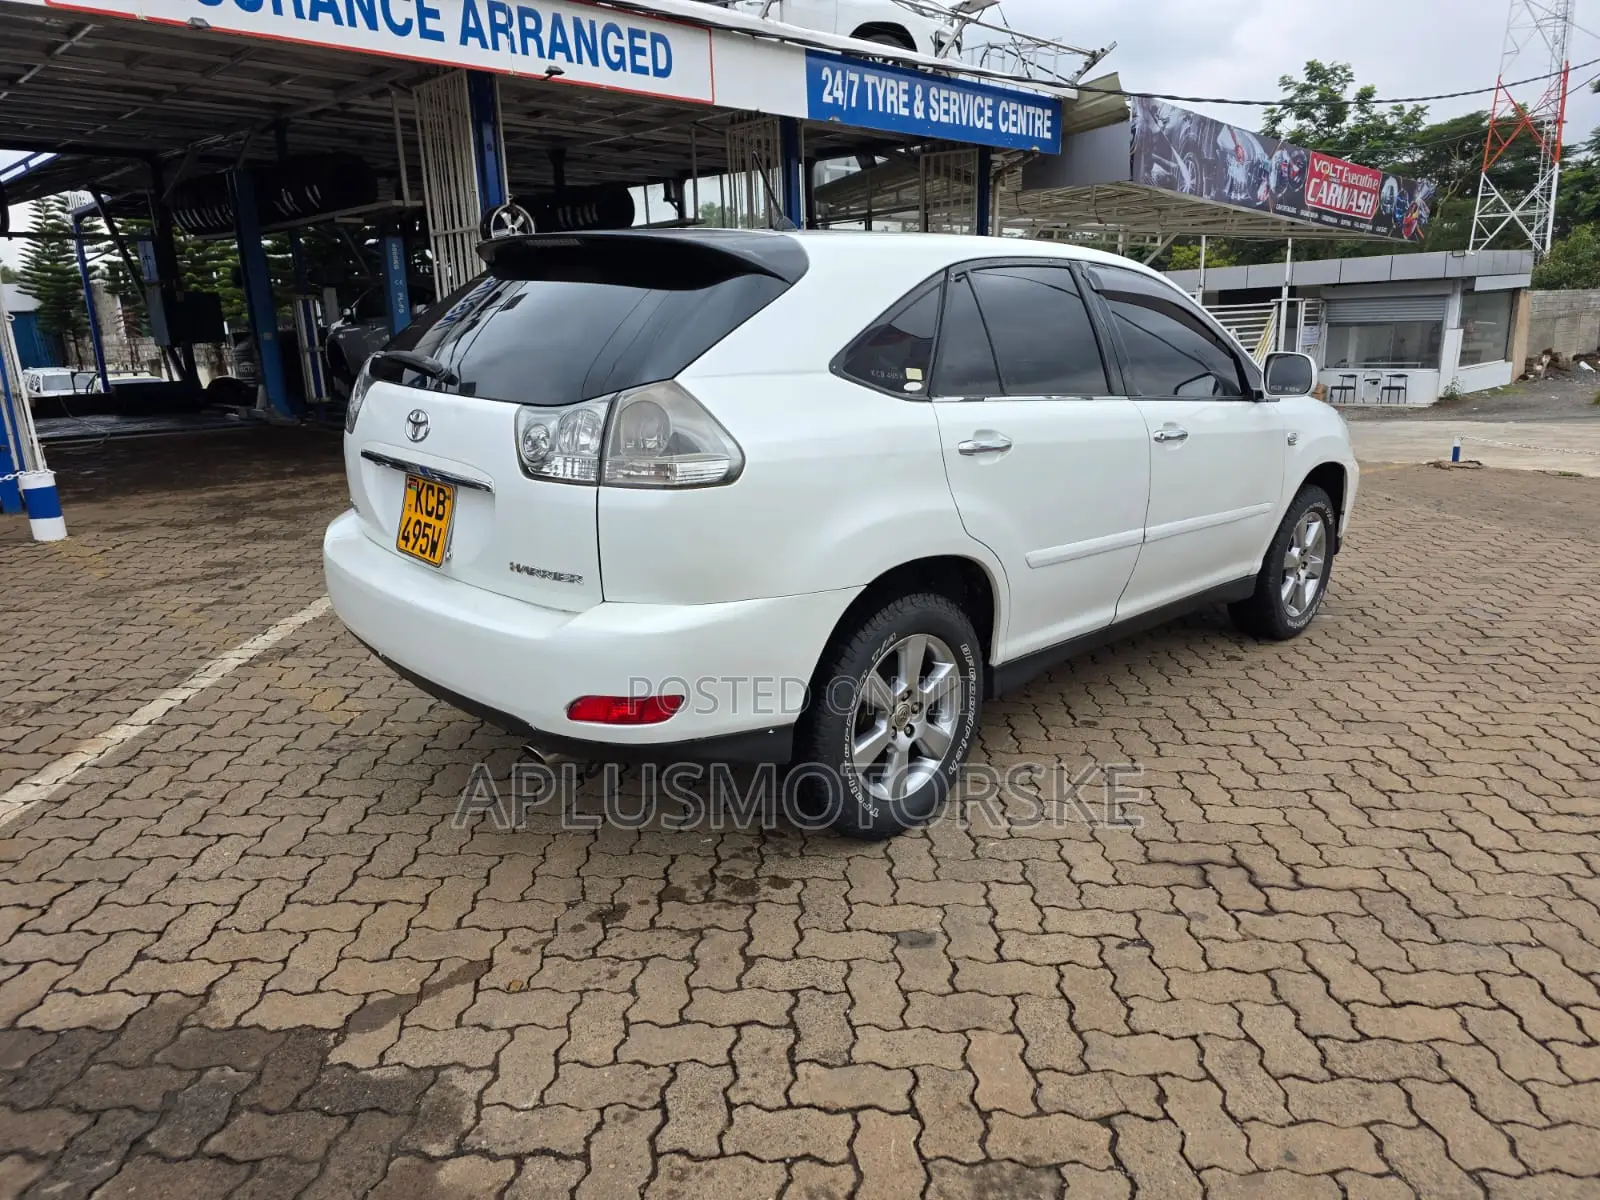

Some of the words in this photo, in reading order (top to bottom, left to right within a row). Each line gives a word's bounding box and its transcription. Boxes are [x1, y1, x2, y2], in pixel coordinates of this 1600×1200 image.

[198, 0, 445, 42] ANCE
[459, 0, 672, 78] ARRANGED
[821, 66, 859, 111] 24/7
[864, 75, 909, 116] TYRE
[914, 83, 925, 118] &
[929, 86, 993, 130] SERVICE
[998, 101, 1052, 139] CENTRE
[1314, 158, 1343, 177] VOLT
[1307, 178, 1375, 214] CARWASH
[414, 480, 447, 521] KCB
[401, 516, 442, 559] 495W
[509, 561, 584, 585] HARRIER
